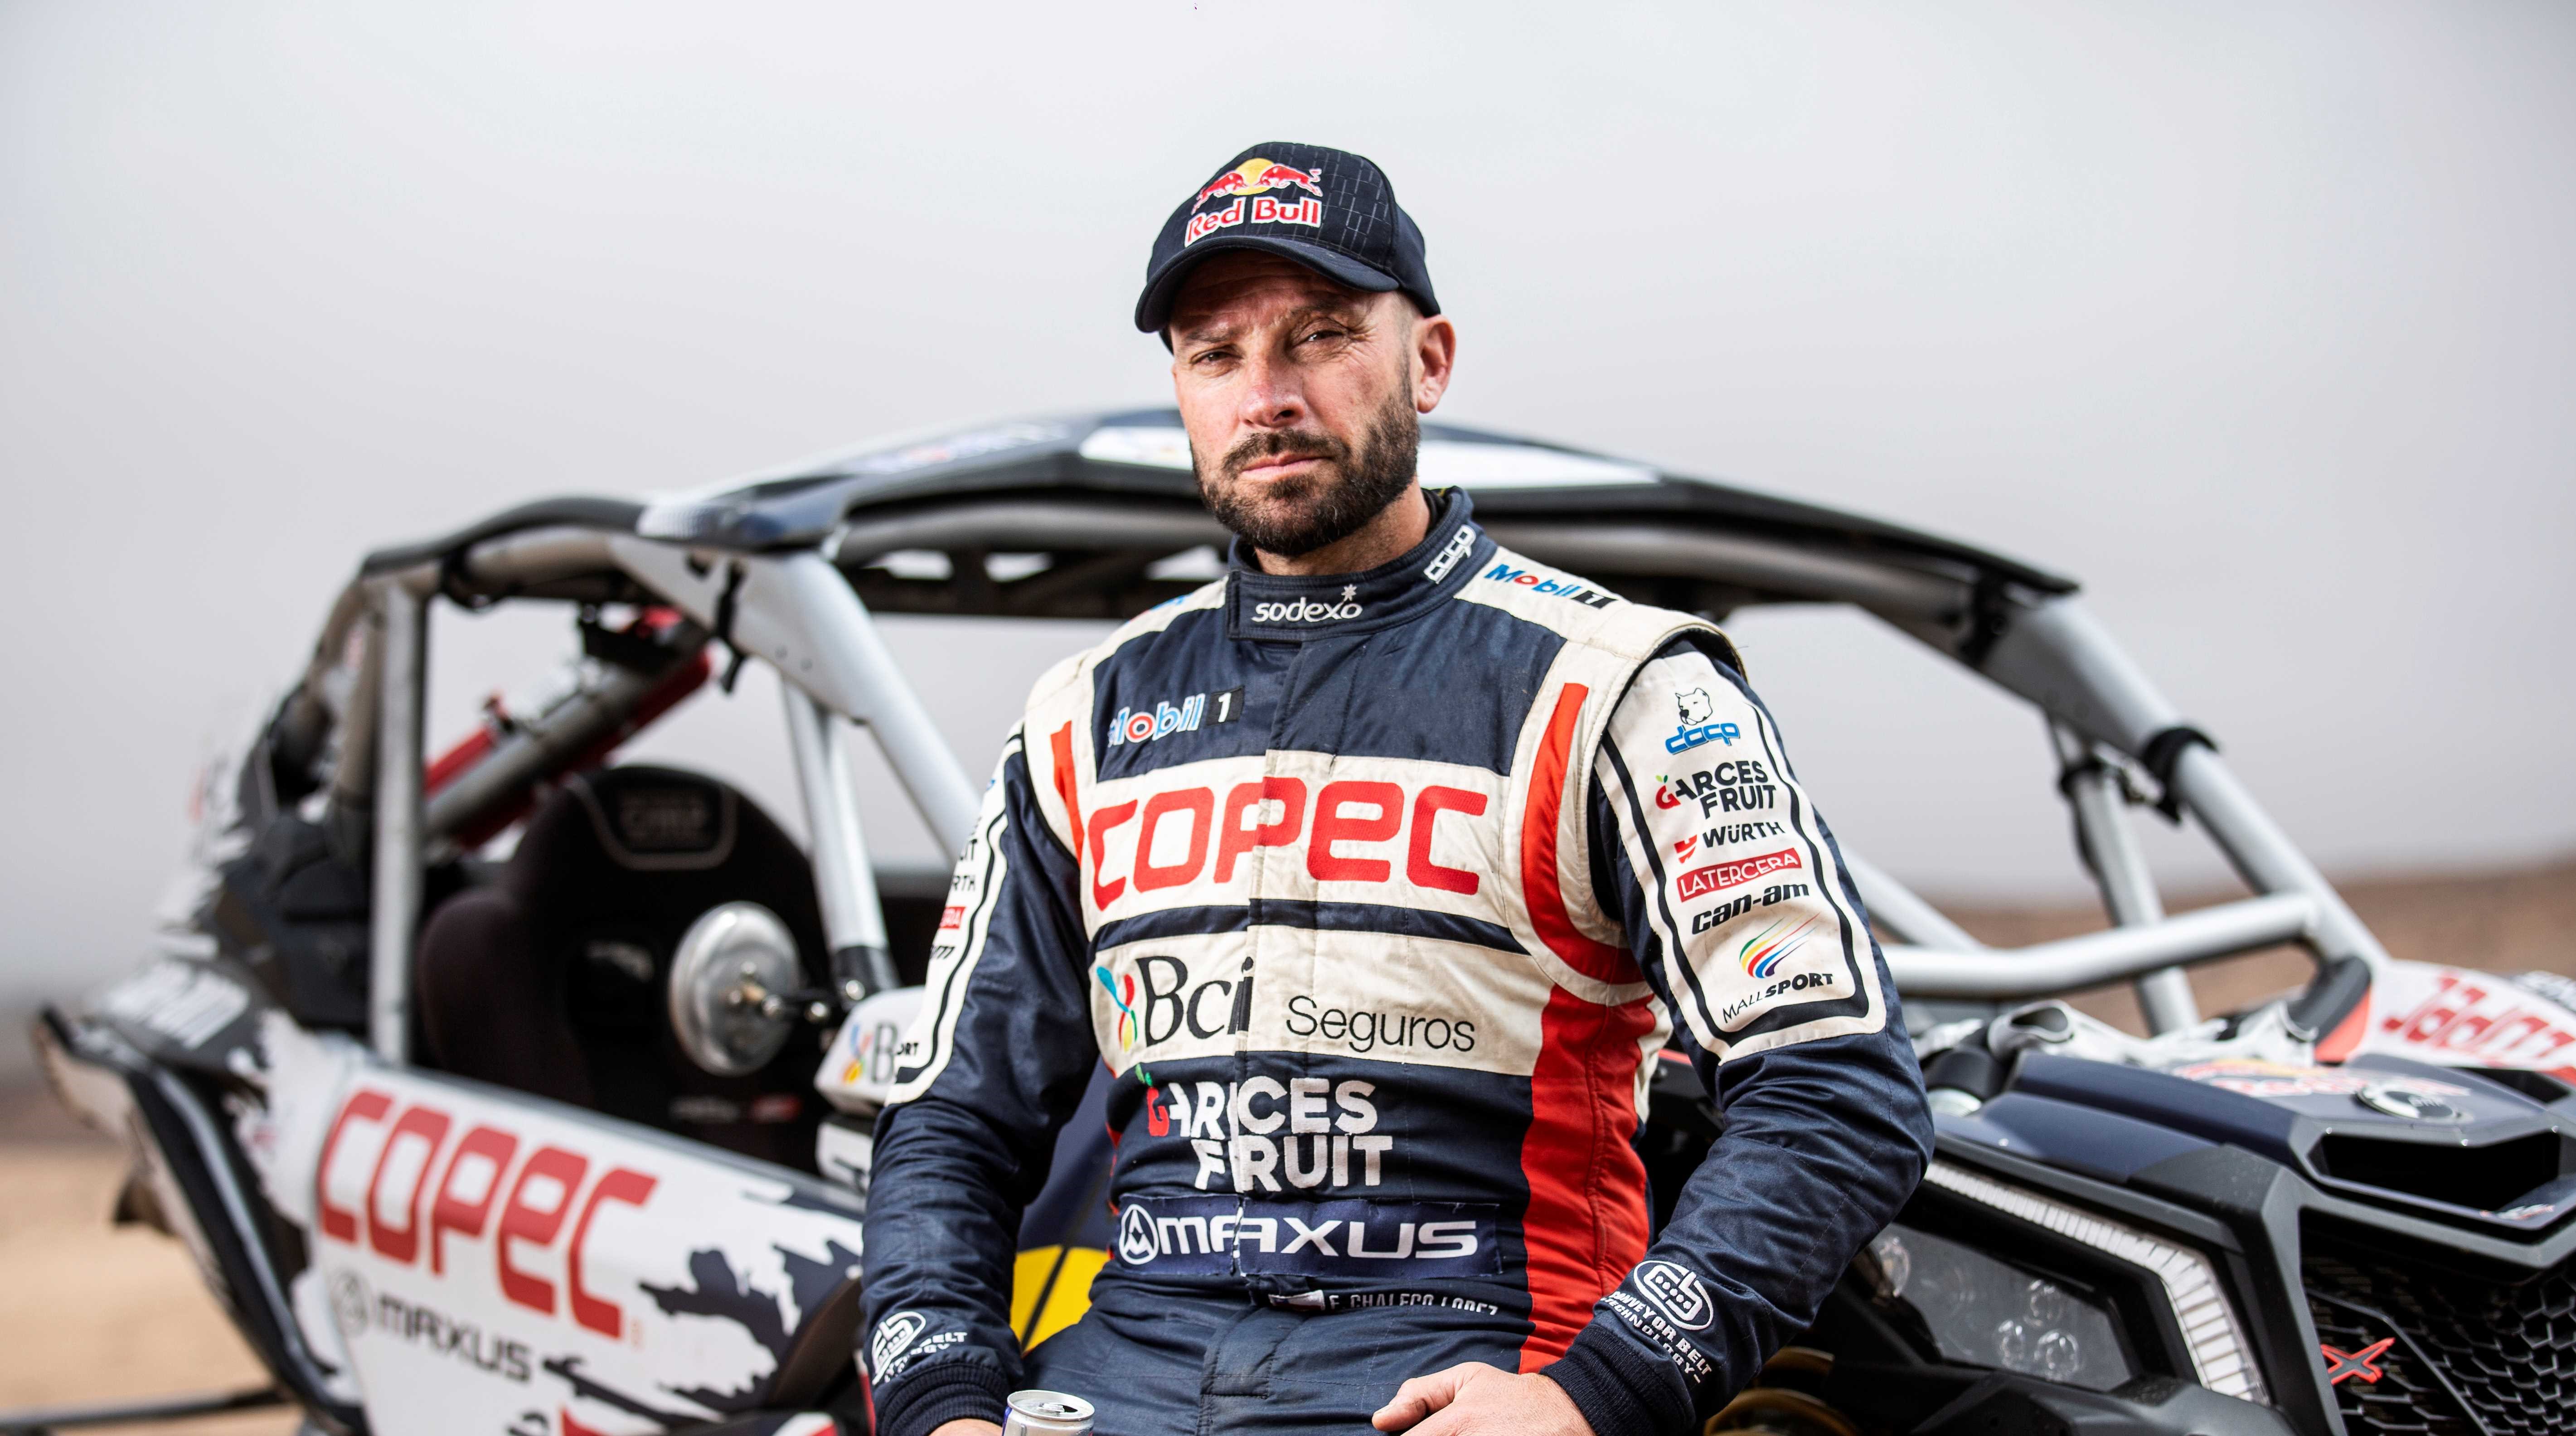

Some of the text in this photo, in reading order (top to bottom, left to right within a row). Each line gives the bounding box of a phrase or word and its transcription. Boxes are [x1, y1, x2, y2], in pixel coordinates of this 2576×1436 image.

[1184, 196, 1322, 247] Red Bull
[1484, 564, 1582, 597] Mobil
[1251, 596, 1363, 623] sodexo
[1655, 760, 1768, 810] GARCES
[1700, 784, 1777, 819] FRUIT
[1703, 822, 1785, 848] WÜRTH
[1691, 883, 1810, 935] can-am
[1135, 955, 1475, 1053] Bci Seguros
[1190, 1135, 1393, 1193] FRUIT
[1157, 1213, 1478, 1259] MAXUS
[1676, 1338, 1712, 1375] BELT
